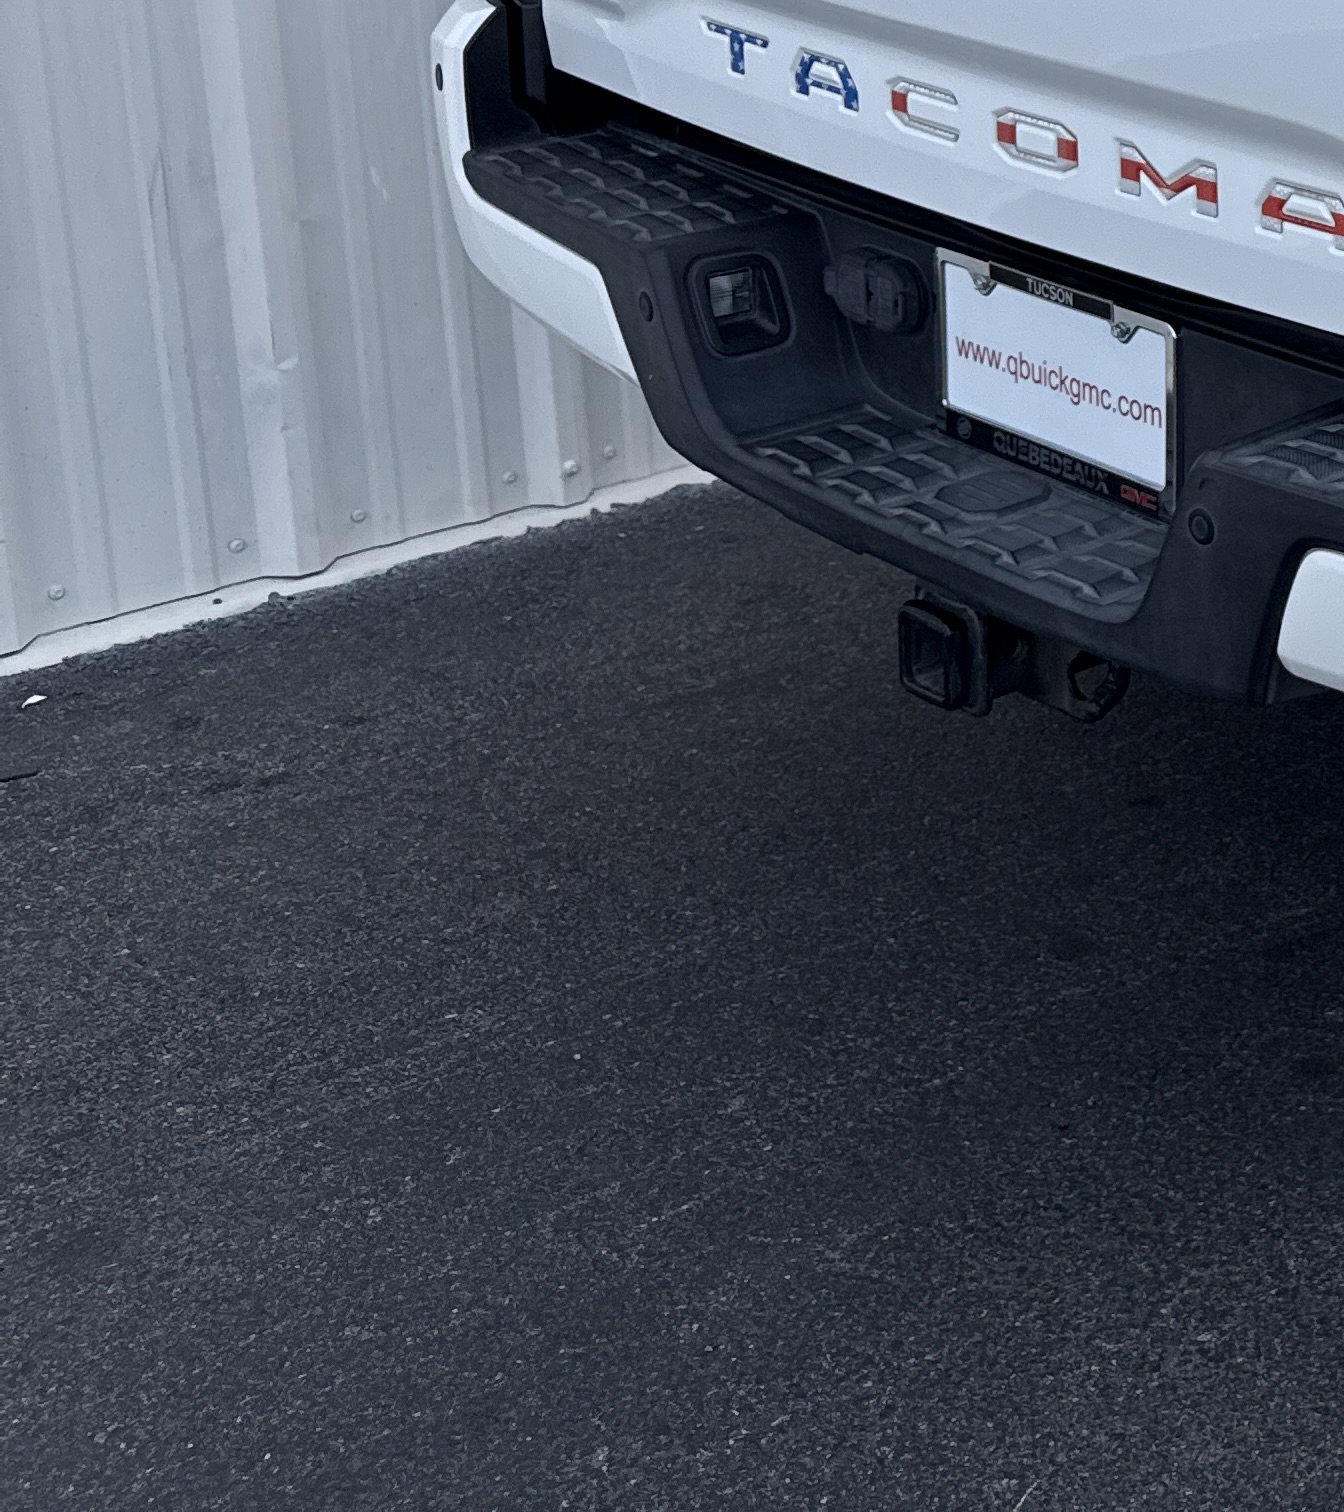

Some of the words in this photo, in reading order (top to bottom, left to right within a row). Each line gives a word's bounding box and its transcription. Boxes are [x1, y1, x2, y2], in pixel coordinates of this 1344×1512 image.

[1026, 277, 1074, 307] TUCSON
[955, 336, 1163, 429] www.qbuickgmc.com
[993, 430, 1110, 495] QUEBEDEAUX
[1120, 484, 1158, 511] GMC
